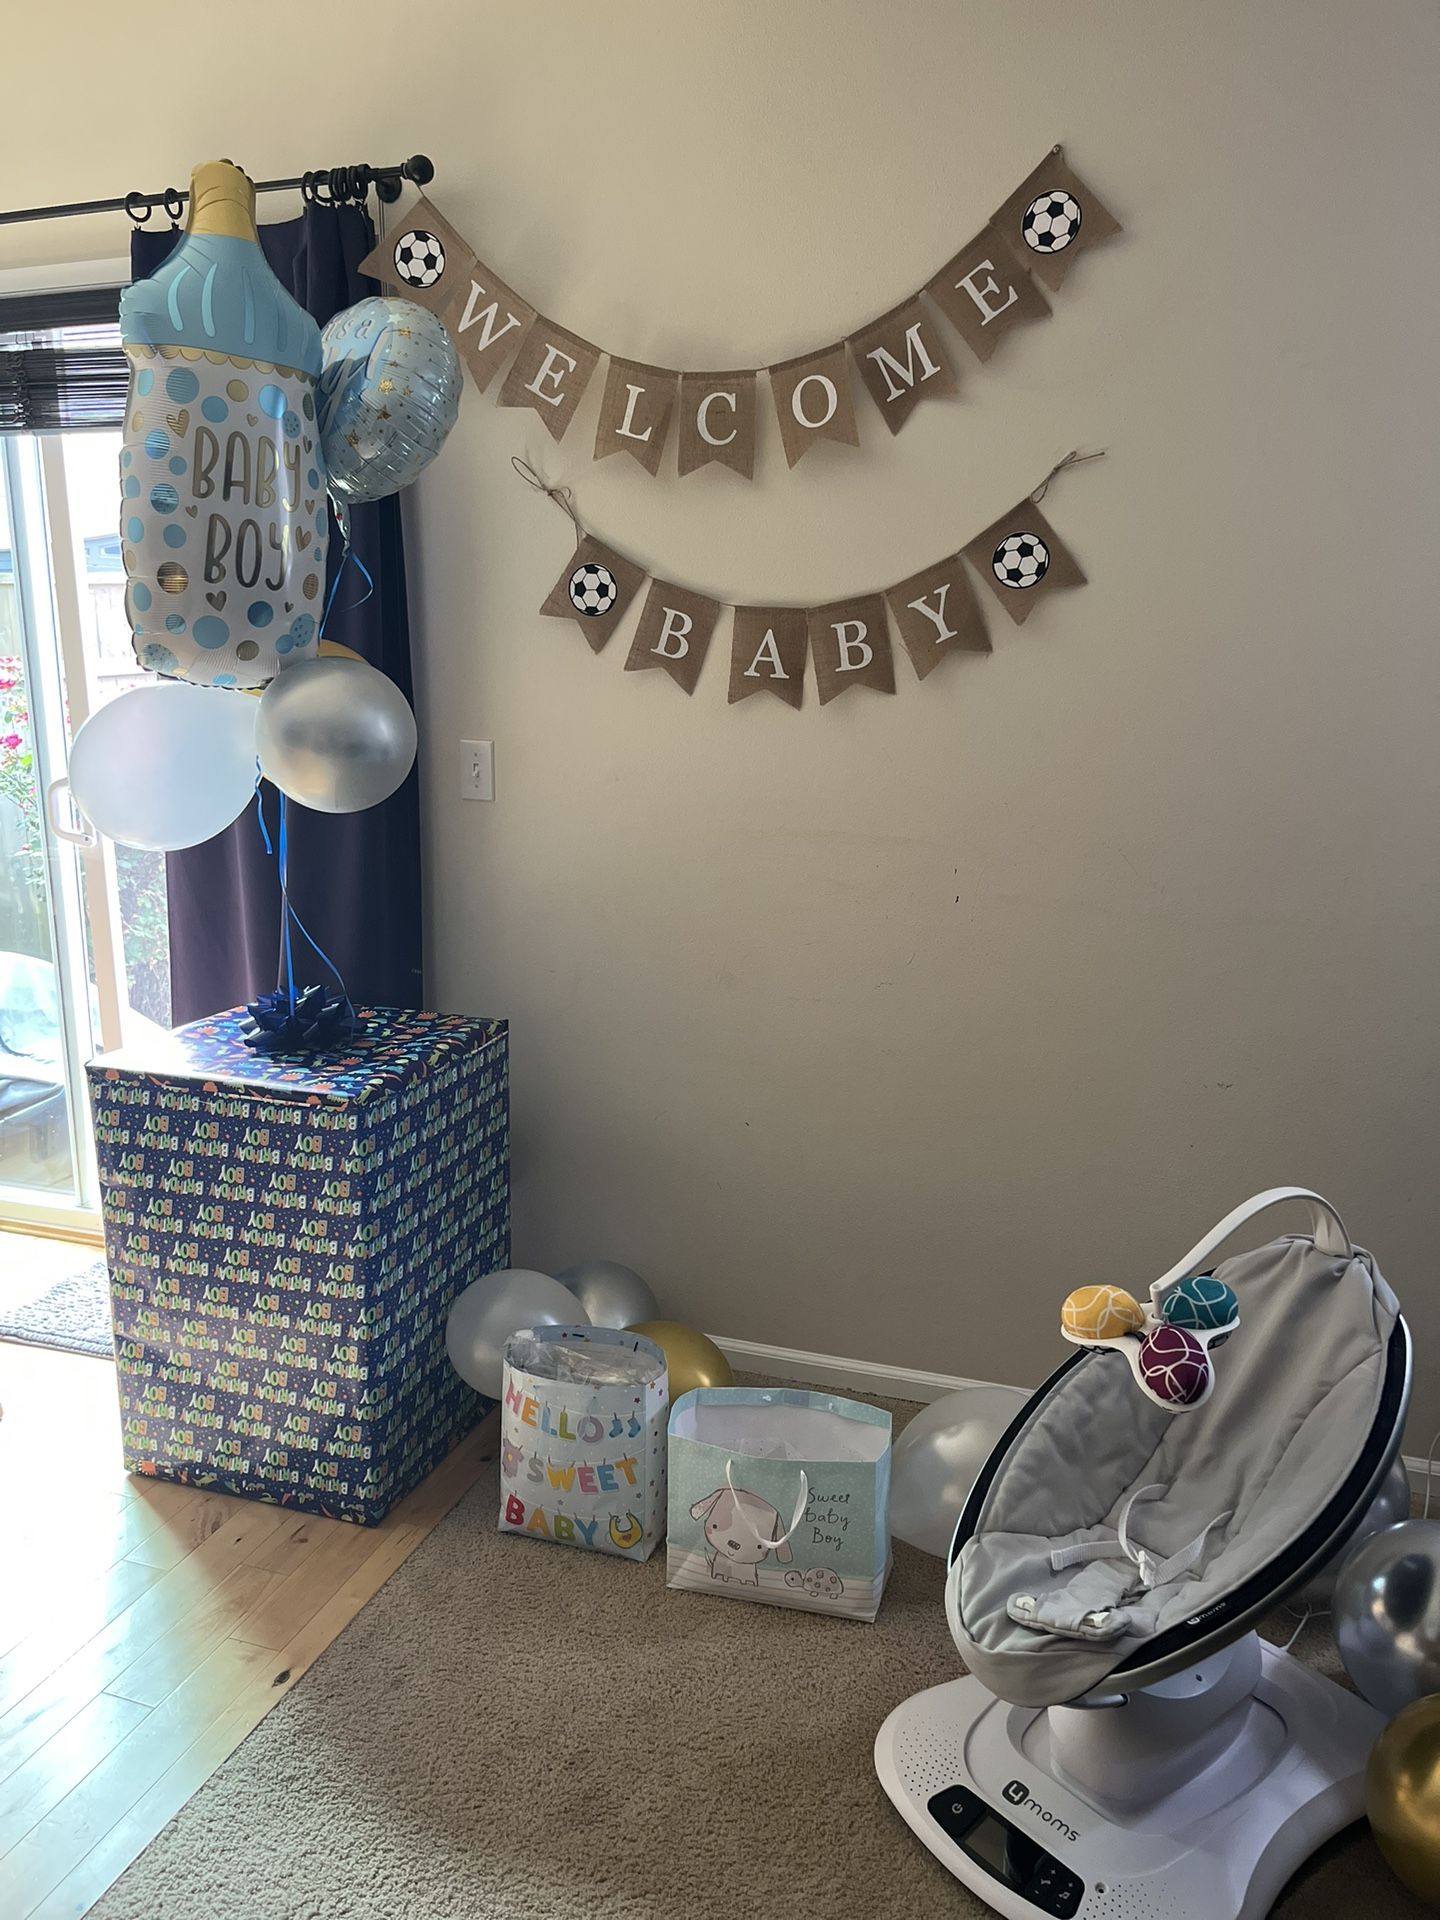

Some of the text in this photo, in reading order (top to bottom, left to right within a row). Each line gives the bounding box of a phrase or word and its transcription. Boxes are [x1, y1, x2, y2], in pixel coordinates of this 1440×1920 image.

[456, 260, 1019, 447] WELCOME
[191, 426, 302, 512] BABY
[203, 512, 288, 591] BOY
[650, 583, 958, 679] BABY
[143, 1113, 168, 1132] BOY
[192, 1119, 218, 1138] BOY
[242, 1126, 269, 1145] BOY
[294, 1132, 322, 1152] BOY
[118, 1151, 143, 1170] BOY
[167, 1158, 192, 1176] BOY
[218, 1164, 244, 1182] BOY
[268, 1171, 296, 1190] BOY
[321, 1177, 350, 1197] BOY
[146, 1196, 171, 1215] BOY
[196, 1203, 222, 1221] BOY
[247, 1210, 274, 1229] BOY
[299, 1216, 327, 1236] BOY
[125, 1232, 149, 1250] BOY
[172, 1239, 197, 1258] BOY
[223, 1246, 248, 1265] BOY
[273, 1254, 300, 1273] BOY
[325, 1261, 353, 1281] BOY
[155, 1275, 180, 1293] BOY
[202, 1283, 228, 1302] BOY
[252, 1291, 279, 1310] BOY
[304, 1299, 331, 1318] BOY
[136, 1307, 159, 1325] BOY
[182, 1316, 207, 1334] BOY
[231, 1324, 256, 1343] BOY
[280, 1333, 306, 1352] BOY
[166, 1349, 190, 1367] BOY
[331, 1342, 358, 1361] BOY
[213, 1358, 238, 1376] BOY
[261, 1368, 287, 1386] BOY
[141, 1383, 165, 1401] BOY
[309, 1378, 336, 1397] BOY
[188, 1392, 213, 1410] BOY
[237, 1402, 262, 1420] BOY
[507, 1381, 604, 1443] HELLO
[283, 1413, 309, 1432] BOY
[333, 1422, 360, 1442] BOY
[169, 1426, 193, 1444] BOY
[215, 1436, 240, 1455] BOY
[262, 1448, 288, 1466] BOY
[311, 1458, 338, 1476] BOY
[527, 1457, 638, 1493] SWEET
[807, 1487, 850, 1506] Sweet
[504, 1494, 599, 1546] BABY
[805, 1505, 851, 1530] baby
[812, 1527, 844, 1549] Boy
[1002, 1780, 1080, 1842] 4moms
